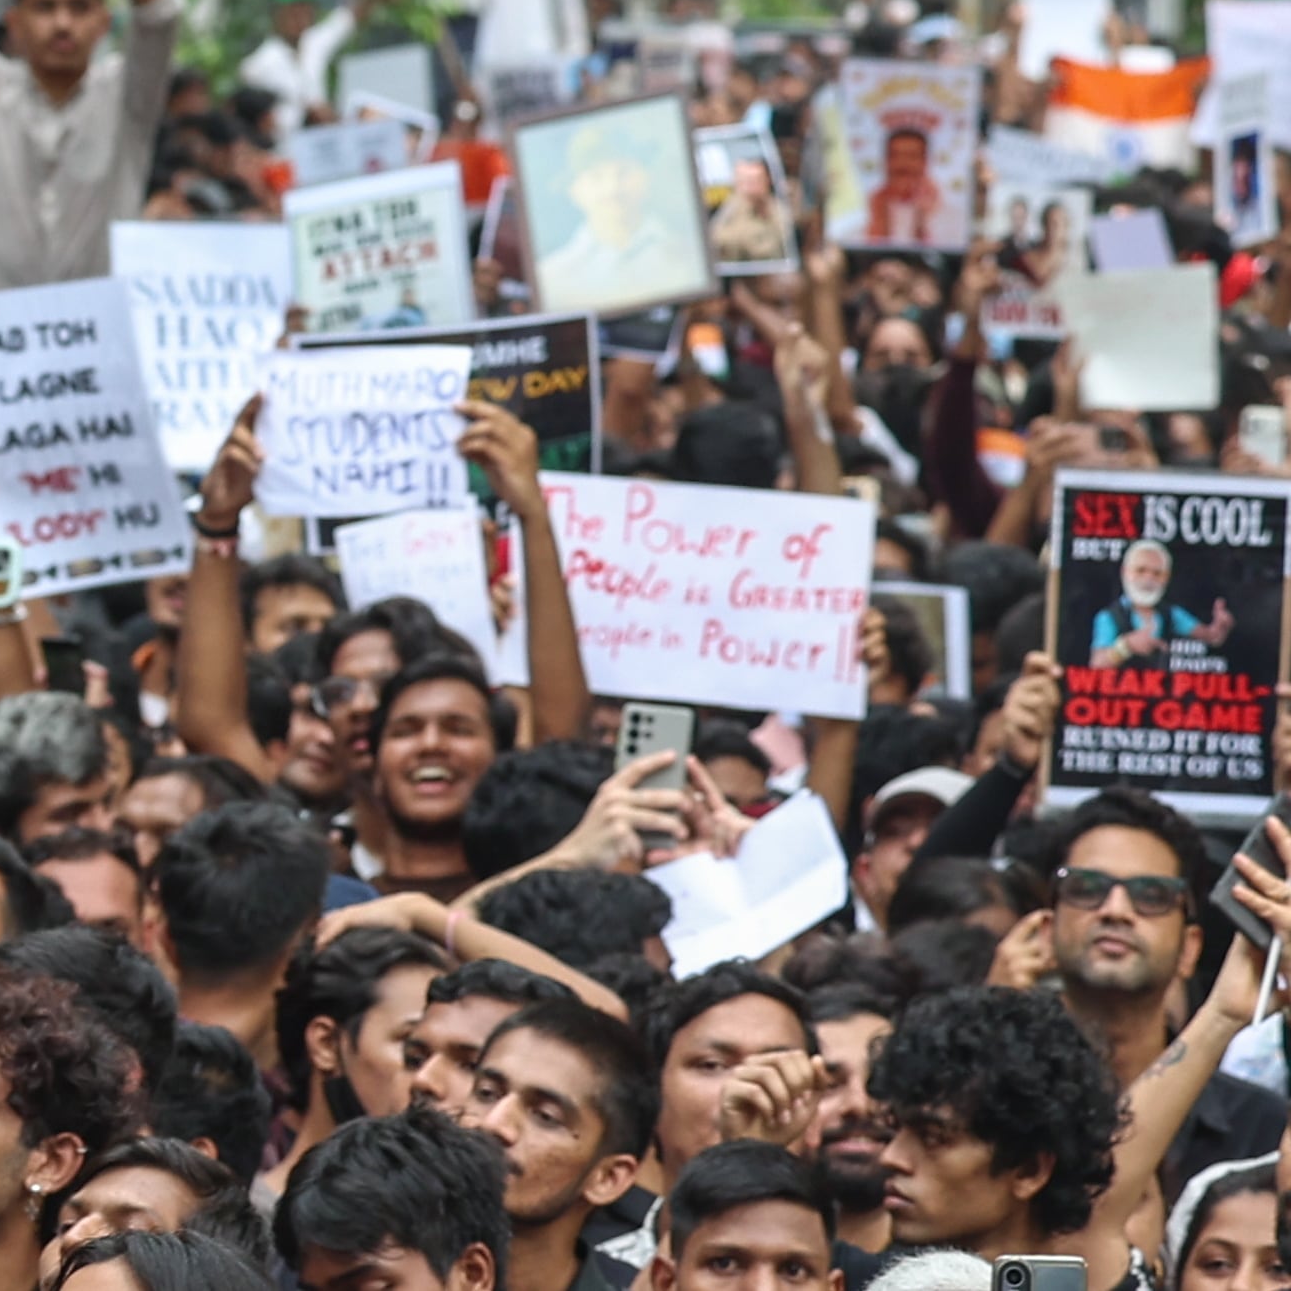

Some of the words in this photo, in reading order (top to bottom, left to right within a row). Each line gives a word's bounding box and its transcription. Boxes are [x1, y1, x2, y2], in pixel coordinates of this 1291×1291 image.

[35, 320, 97, 348] TOH
[522, 364, 588, 400] DAY
[77, 413, 135, 442] HAI
[281, 410, 449, 465] STUDENTS
[88, 463, 122, 486] HI
[115, 504, 160, 530] HU
[542, 486, 606, 541] The
[623, 483, 760, 559] Power
[782, 523, 834, 580] of
[1073, 492, 1140, 538] SEX
[1142, 495, 1177, 541] IS
[1180, 496, 1272, 547] COOL
[1072, 537, 1124, 560] BUT
[659, 624, 685, 649] in
[1066, 665, 1164, 697] WEAK
[1171, 671, 1271, 701] PULL-
[1064, 698, 1147, 728] OUT
[1152, 703, 1263, 733] GAME
[1063, 725, 1171, 754] RUINED
[1174, 730, 1202, 754] IT
[1205, 732, 1263, 756] FOR
[1060, 749, 1115, 774] THE
[1118, 752, 1183, 777] REST
[1186, 755, 1219, 778] OF
[1226, 757, 1264, 781] US
